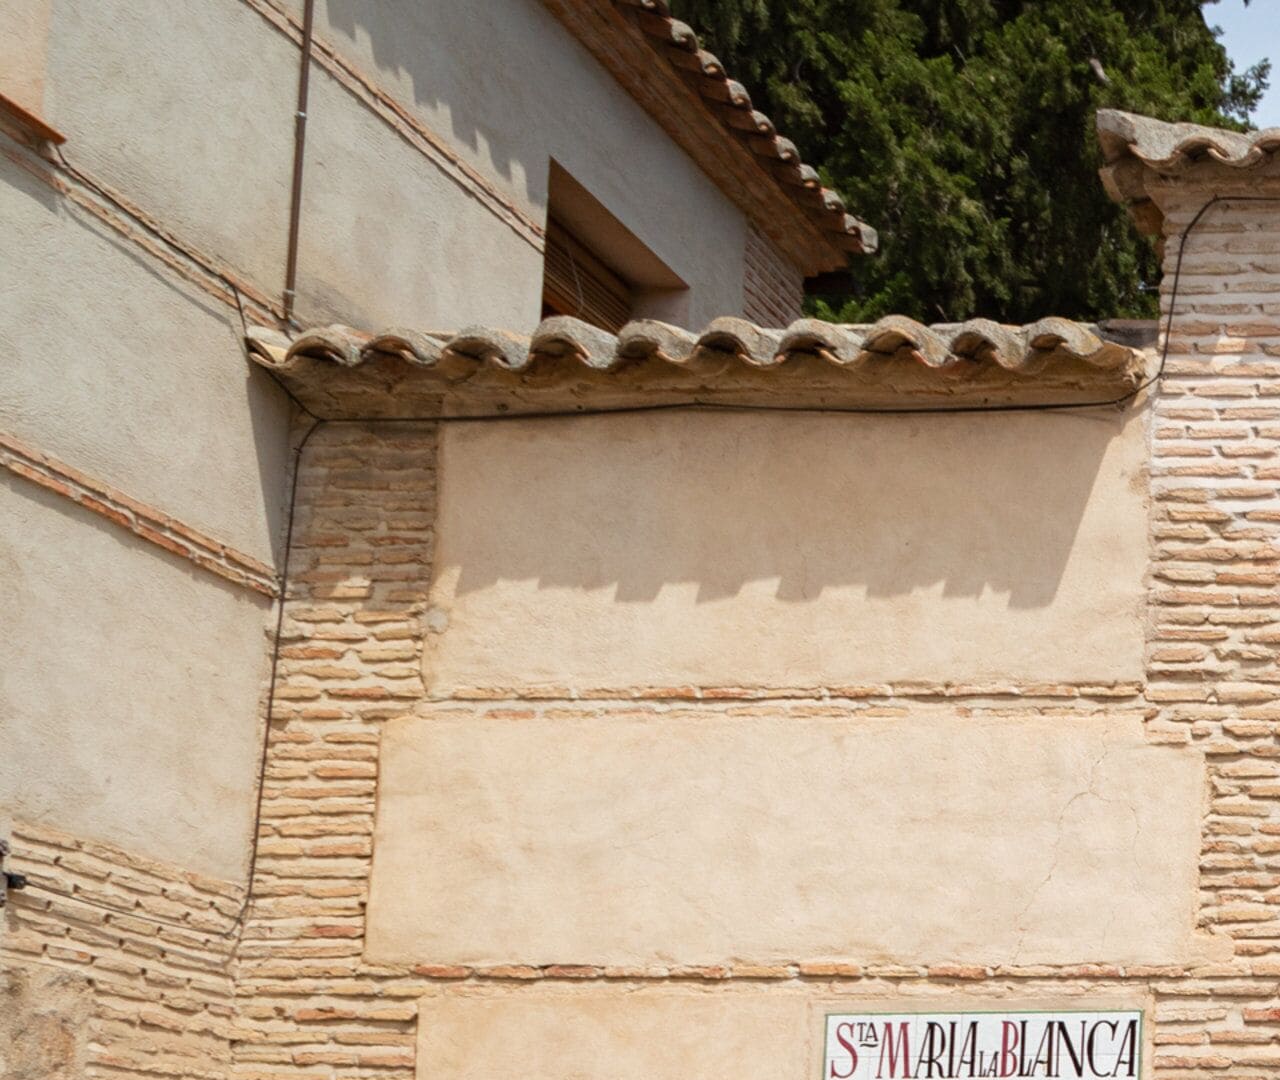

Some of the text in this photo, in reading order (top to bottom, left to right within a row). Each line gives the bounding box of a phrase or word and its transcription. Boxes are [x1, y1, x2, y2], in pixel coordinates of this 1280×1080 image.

[876, 1021, 979, 1079] MARIA
[979, 1050, 999, 1078] LA
[999, 1019, 1138, 1078] BLANCA
